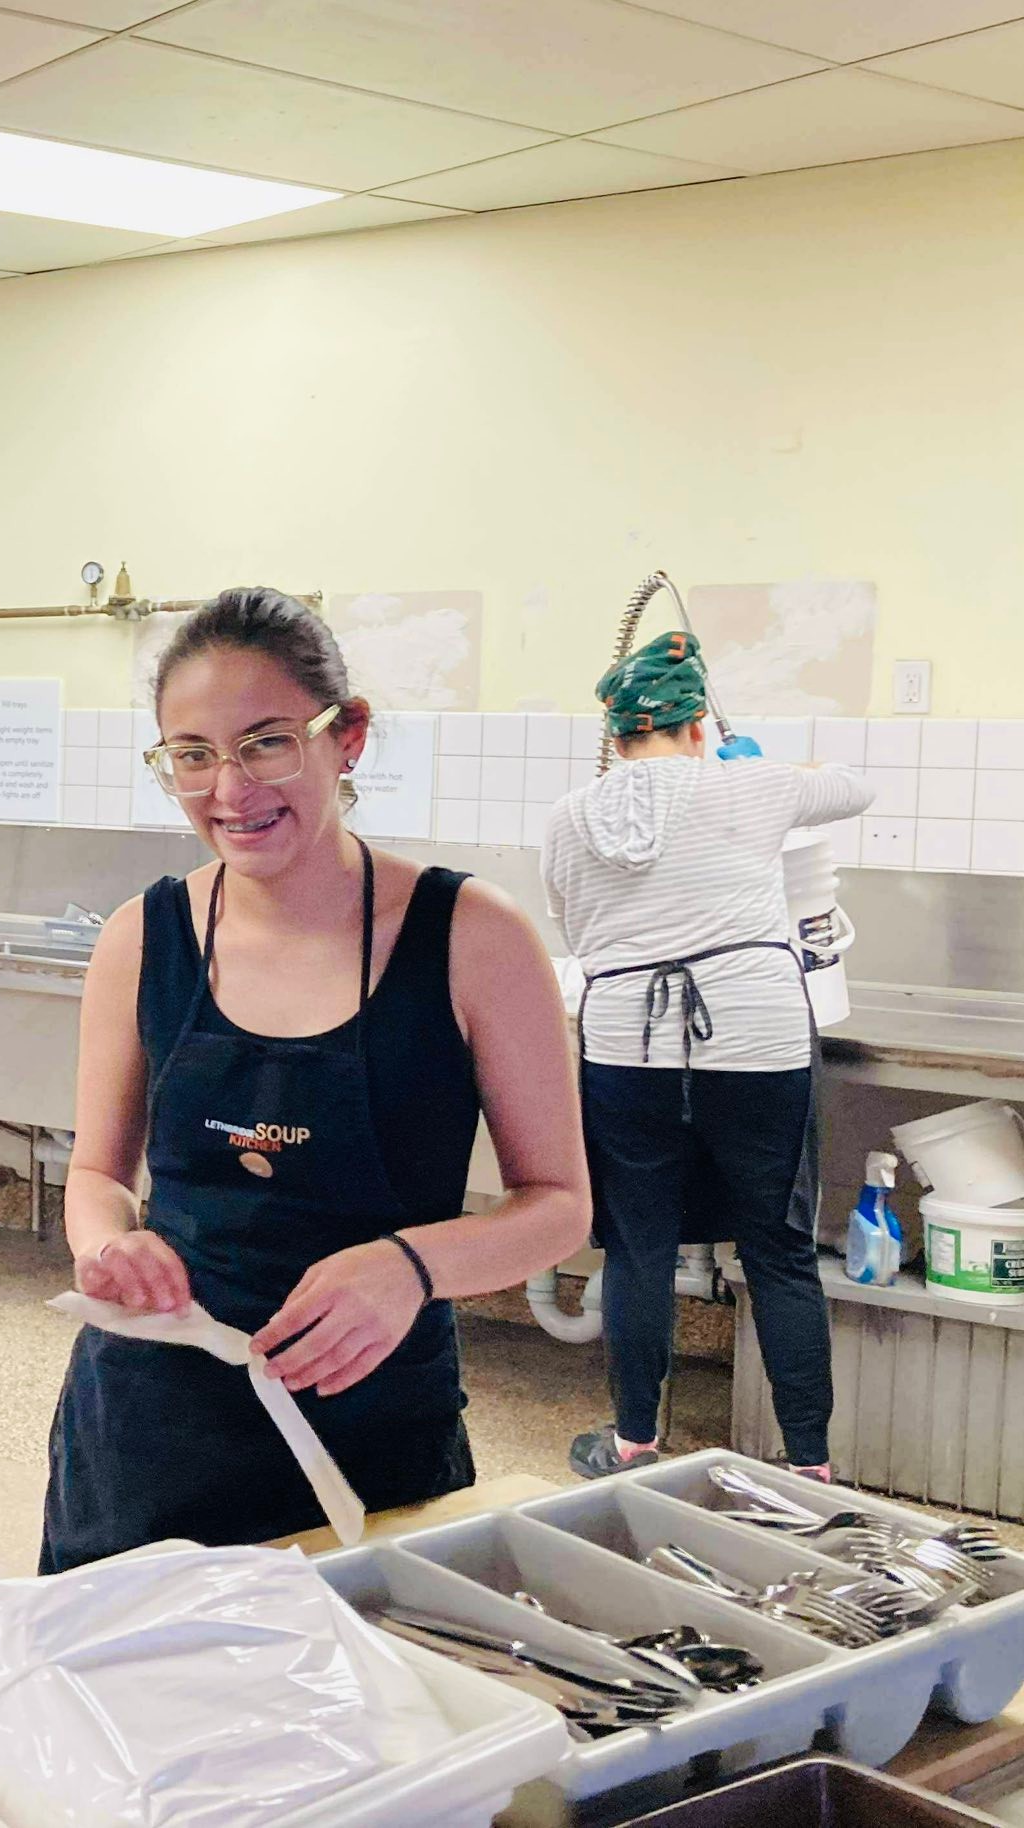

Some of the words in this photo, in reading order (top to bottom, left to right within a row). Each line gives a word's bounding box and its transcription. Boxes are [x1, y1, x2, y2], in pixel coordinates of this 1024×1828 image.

[12, 726, 33, 736] weight
[35, 726, 53, 734] items
[5, 737, 25, 745] empty
[5, 780, 17, 788] and
[36, 781, 48, 790] and
[254, 1122, 311, 1145] SOUP
